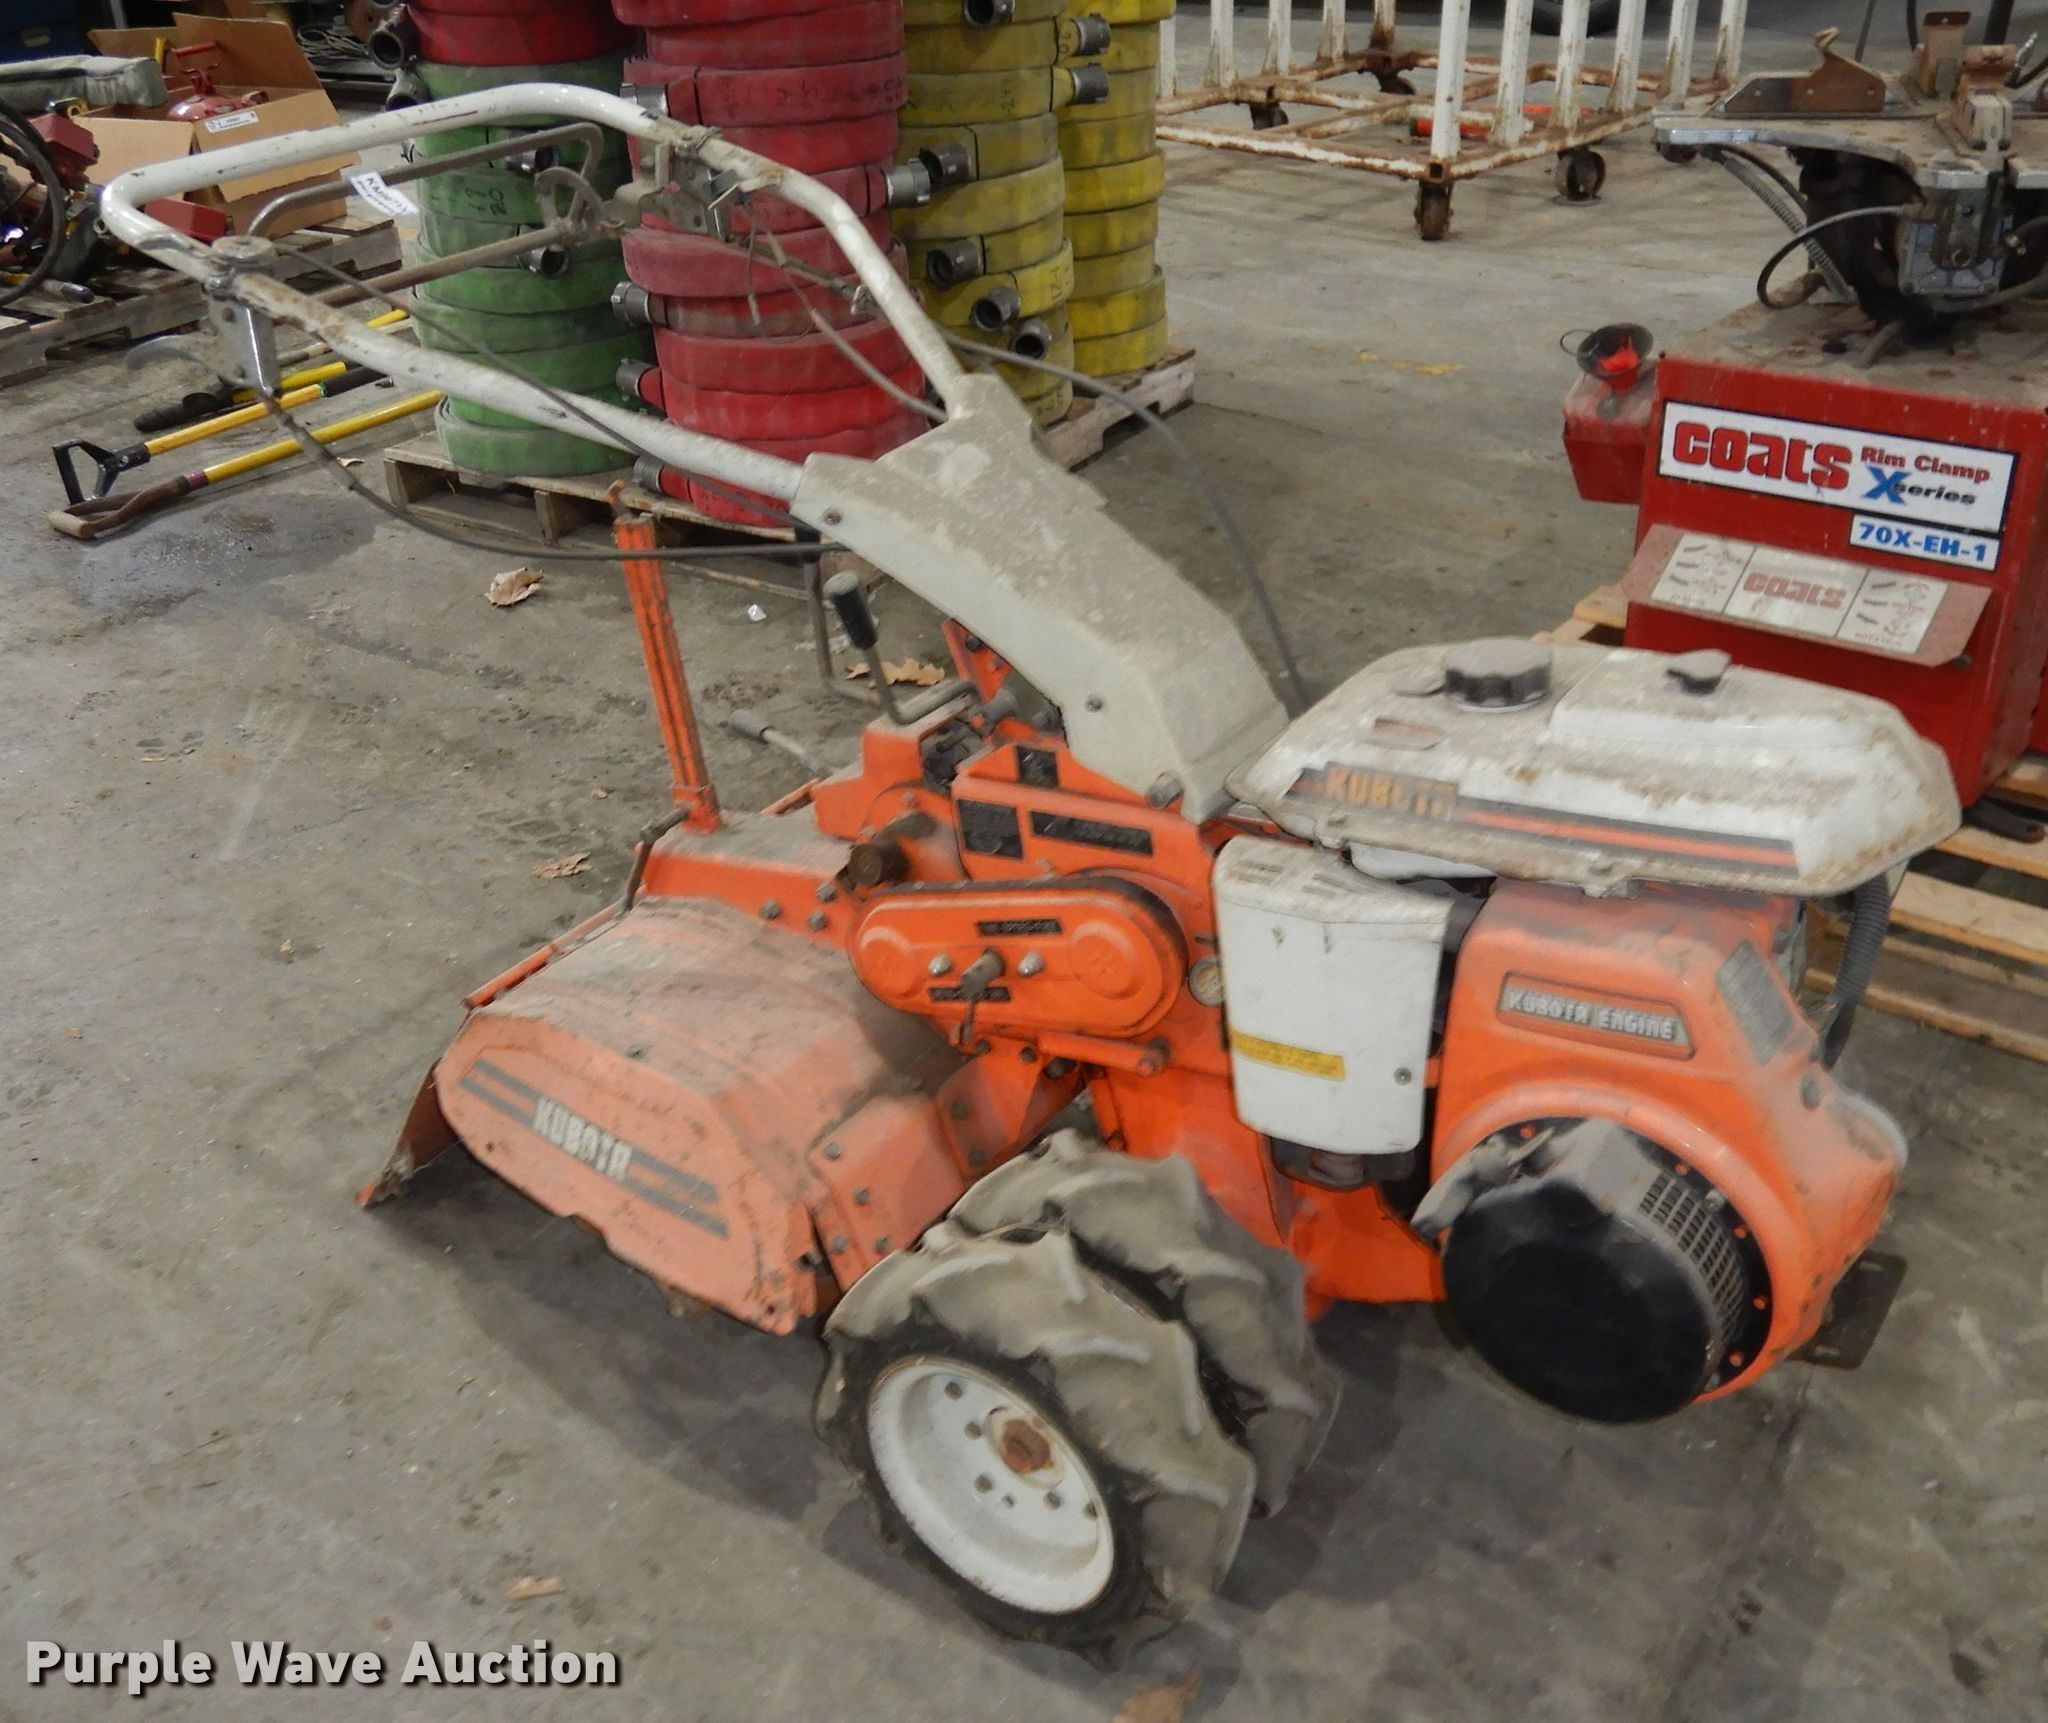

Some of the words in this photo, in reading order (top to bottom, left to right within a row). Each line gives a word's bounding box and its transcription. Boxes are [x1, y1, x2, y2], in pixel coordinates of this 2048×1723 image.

[1861, 446, 1906, 468] Rim
[1914, 454, 1991, 484] Clamp
[1859, 522, 1987, 562] 70X-EH-1
[1598, 1007, 1677, 1041] ENGINE
[533, 1097, 633, 1181] KUBOTA
